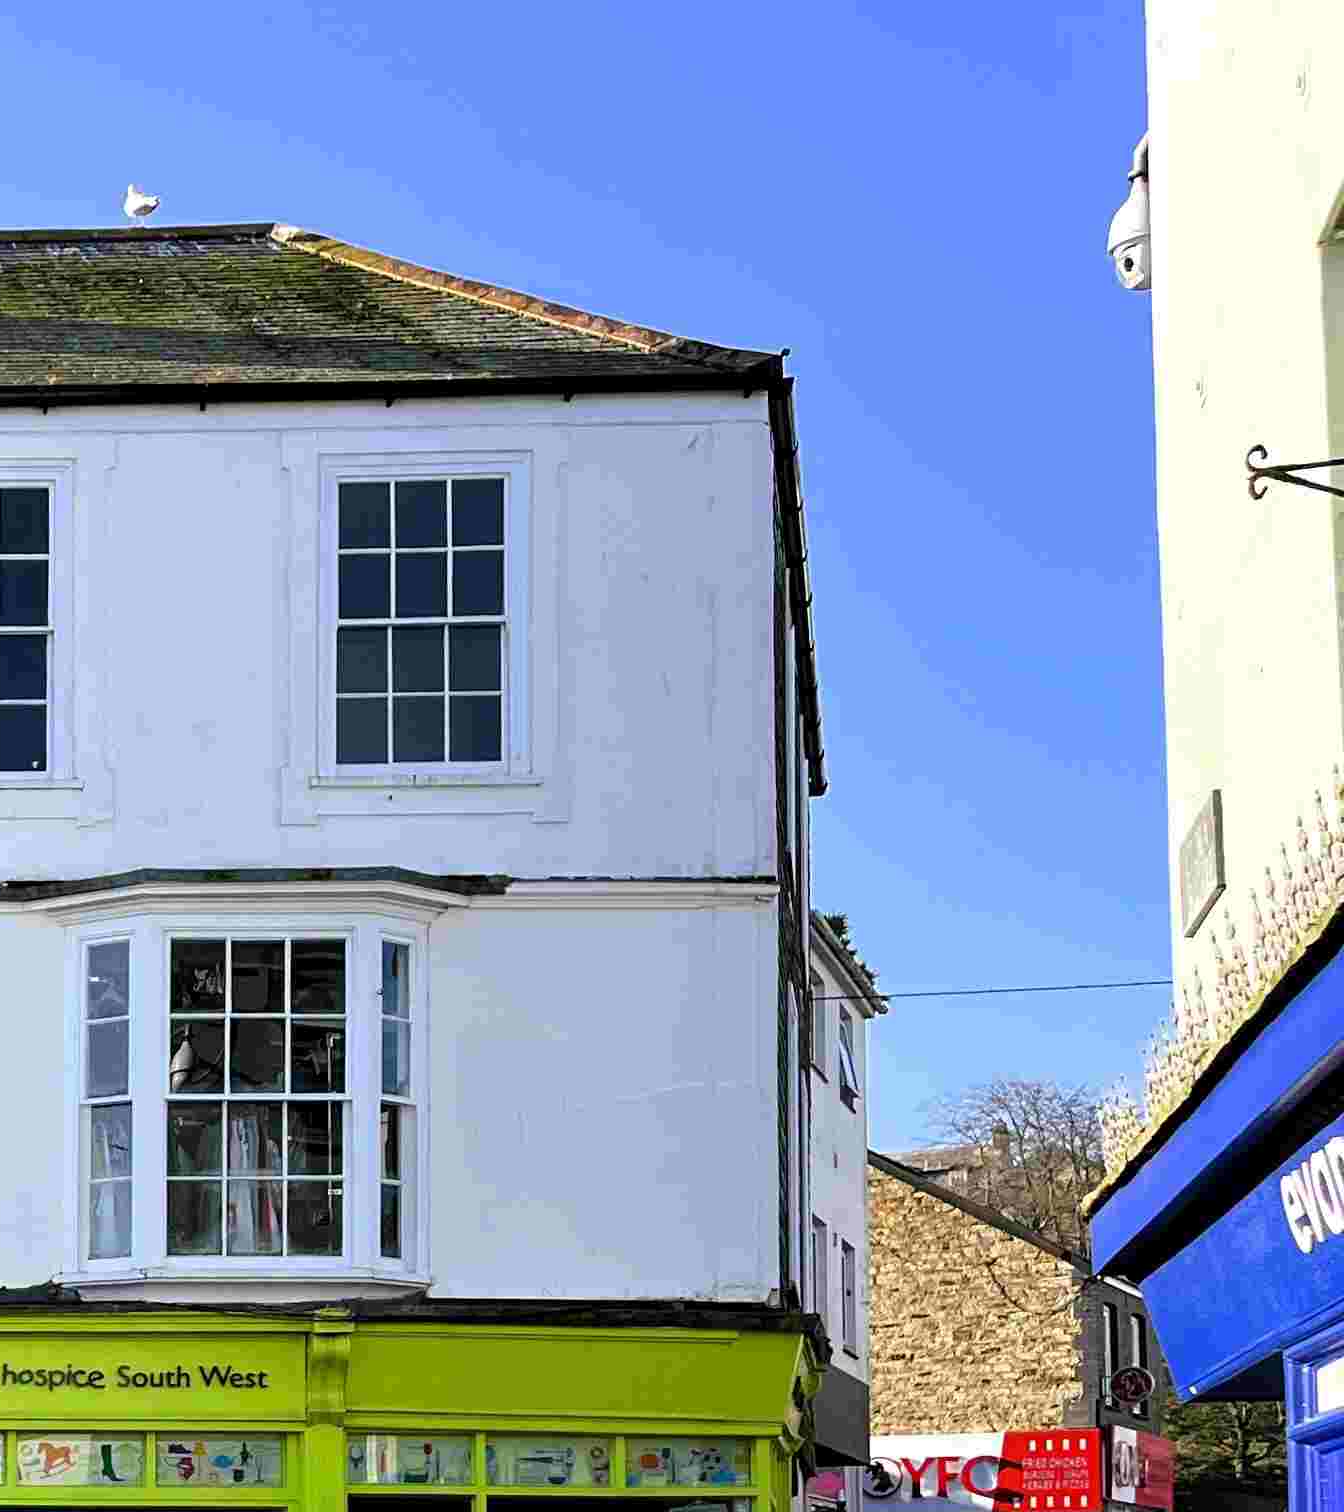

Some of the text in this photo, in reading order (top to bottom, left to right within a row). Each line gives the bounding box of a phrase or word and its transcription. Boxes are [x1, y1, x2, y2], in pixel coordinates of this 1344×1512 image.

[1, 1363, 105, 1391] hospice
[116, 1365, 192, 1389] South
[199, 1365, 269, 1389] West
[900, 1455, 1024, 1501] YFC
